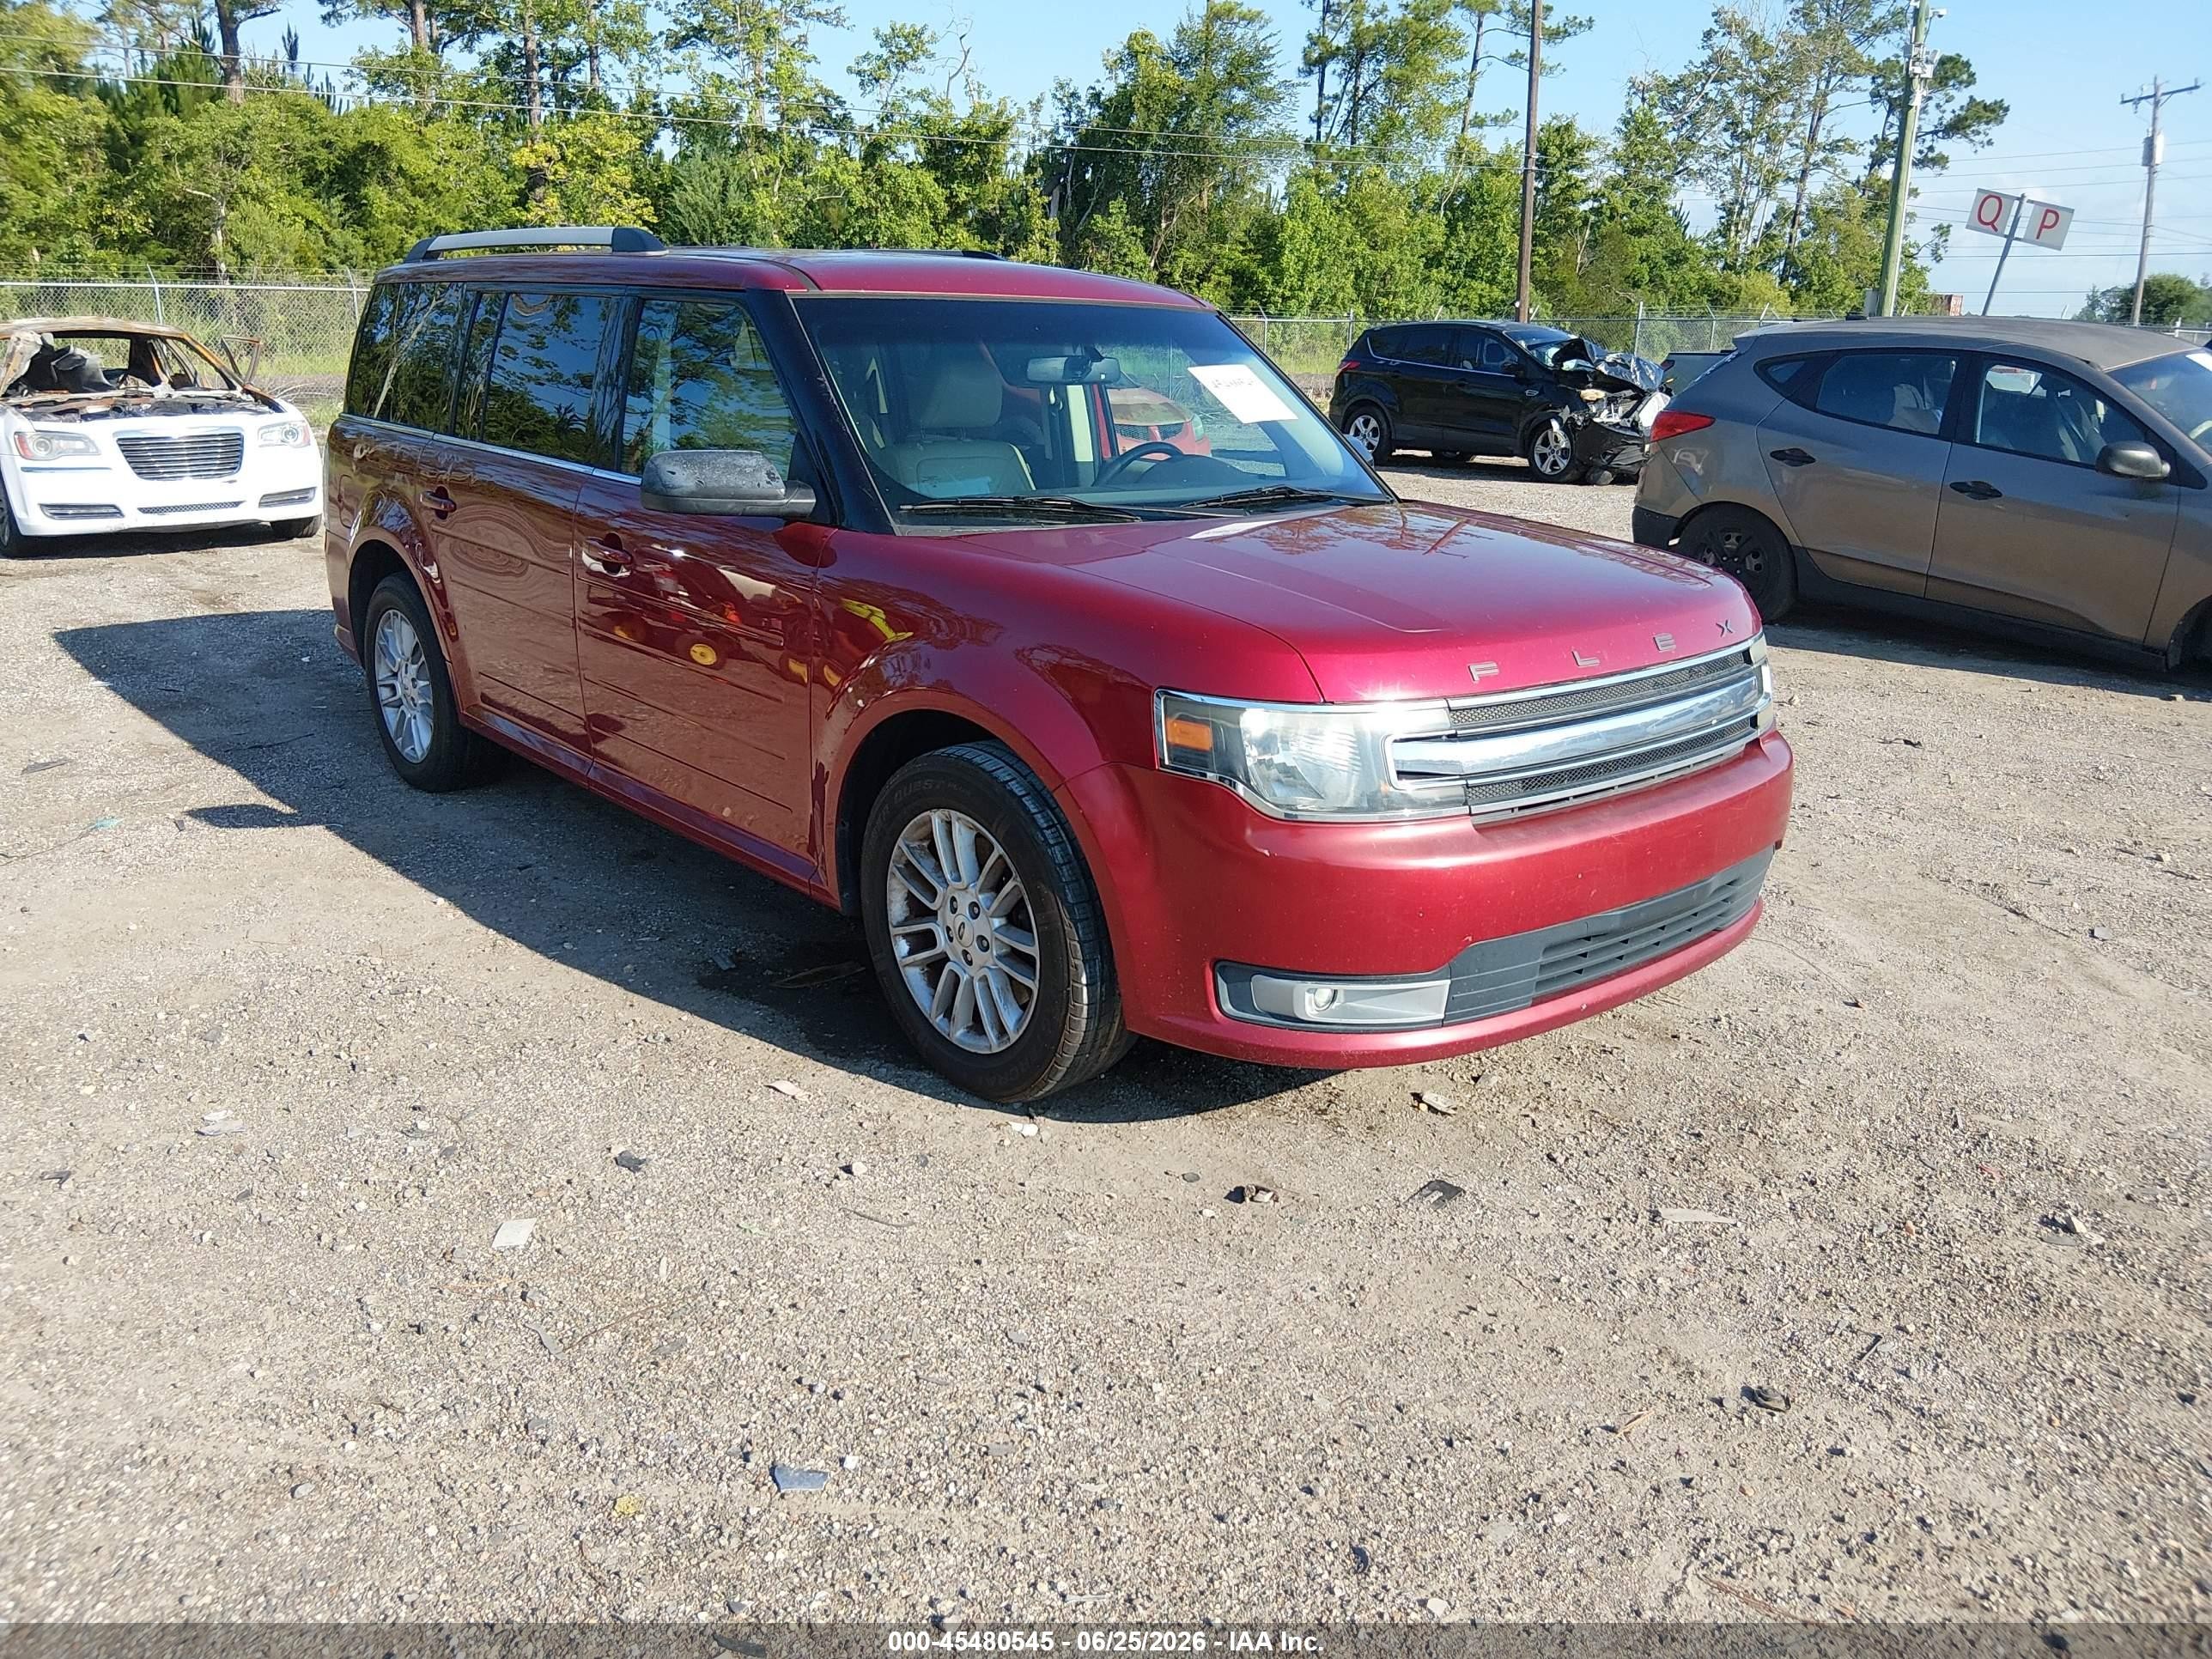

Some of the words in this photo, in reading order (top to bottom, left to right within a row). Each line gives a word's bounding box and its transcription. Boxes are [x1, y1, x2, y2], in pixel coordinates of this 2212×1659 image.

[1977, 194, 2002, 233] Q
[2035, 208, 2060, 240] P
[1468, 619, 1734, 684] FLEX
